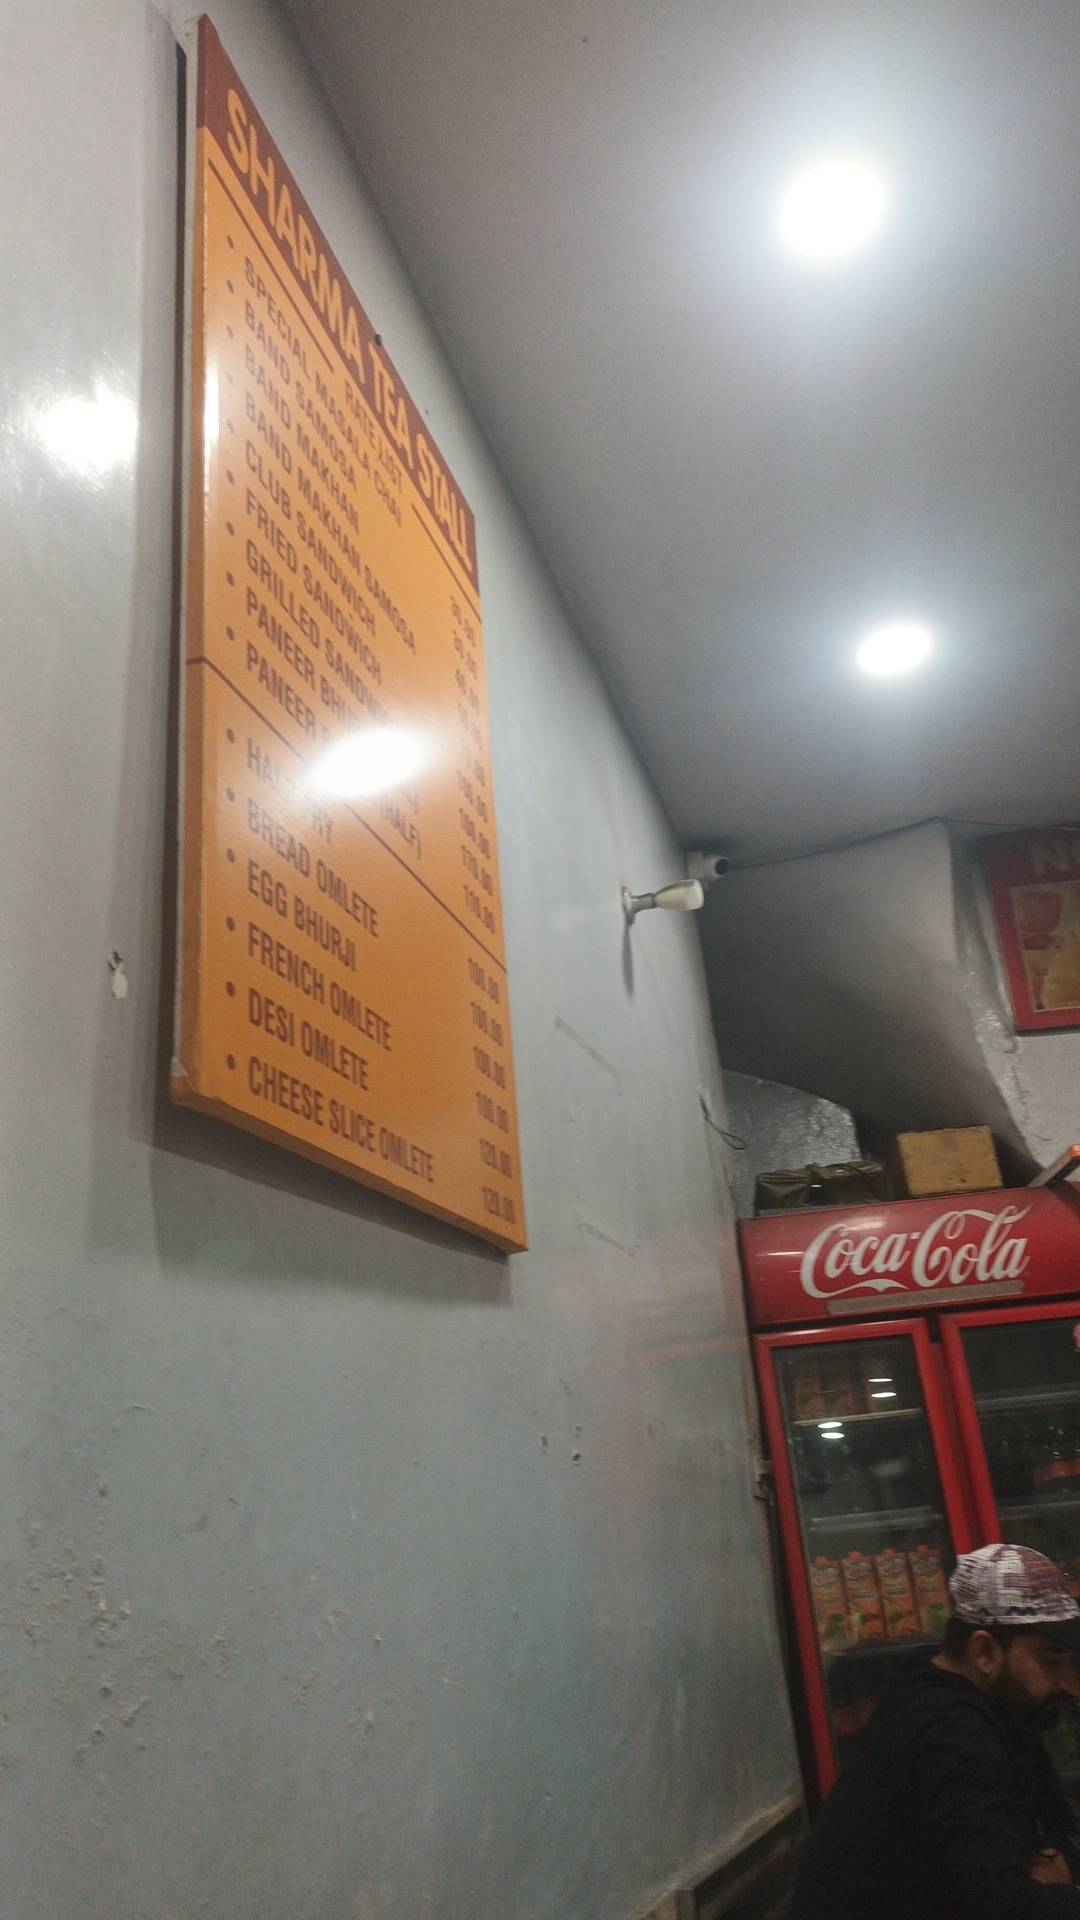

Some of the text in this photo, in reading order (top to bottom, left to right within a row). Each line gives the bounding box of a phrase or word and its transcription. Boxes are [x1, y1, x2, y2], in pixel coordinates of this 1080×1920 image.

[227, 88, 472, 576] SHARMA TEA STALL
[244, 255, 311, 382] SPECIAL
[315, 369, 371, 479] MASALA
[373, 467, 402, 529] CHAI
[245, 299, 289, 387] BAND
[295, 379, 356, 492] SAMOSA
[245, 343, 290, 431] BAND
[296, 422, 359, 535] MAKHAN
[344, 378, 402, 496] RATE LIST
[245, 390, 291, 477] BAND
[297, 467, 361, 577] MAKHAN
[364, 564, 416, 657] SAMOSA
[245, 438, 291, 522] CLUB
[296, 510, 376, 638] SANDWICH
[246, 488, 296, 575] FRIED
[303, 564, 382, 687] SANDWICH
[246, 537, 319, 651] GRILLED
[247, 587, 314, 690] PANEER
[247, 641, 315, 740] PANEER
[248, 799, 310, 878] BREAD
[315, 859, 379, 938] OMLETE
[248, 859, 287, 918] EGG
[293, 896, 356, 972] BHURJI
[248, 923, 324, 1005] FRENCH
[330, 983, 392, 1051] OMLETE
[249, 988, 294, 1047] DESI
[301, 1022, 368, 1091] OMLETE
[249, 1057, 324, 1127] CHEESE
[328, 1100, 375, 1153] SLICE
[379, 1128, 434, 1183] OMLETE
[801, 1205, 1032, 1298] Coca-Cola
